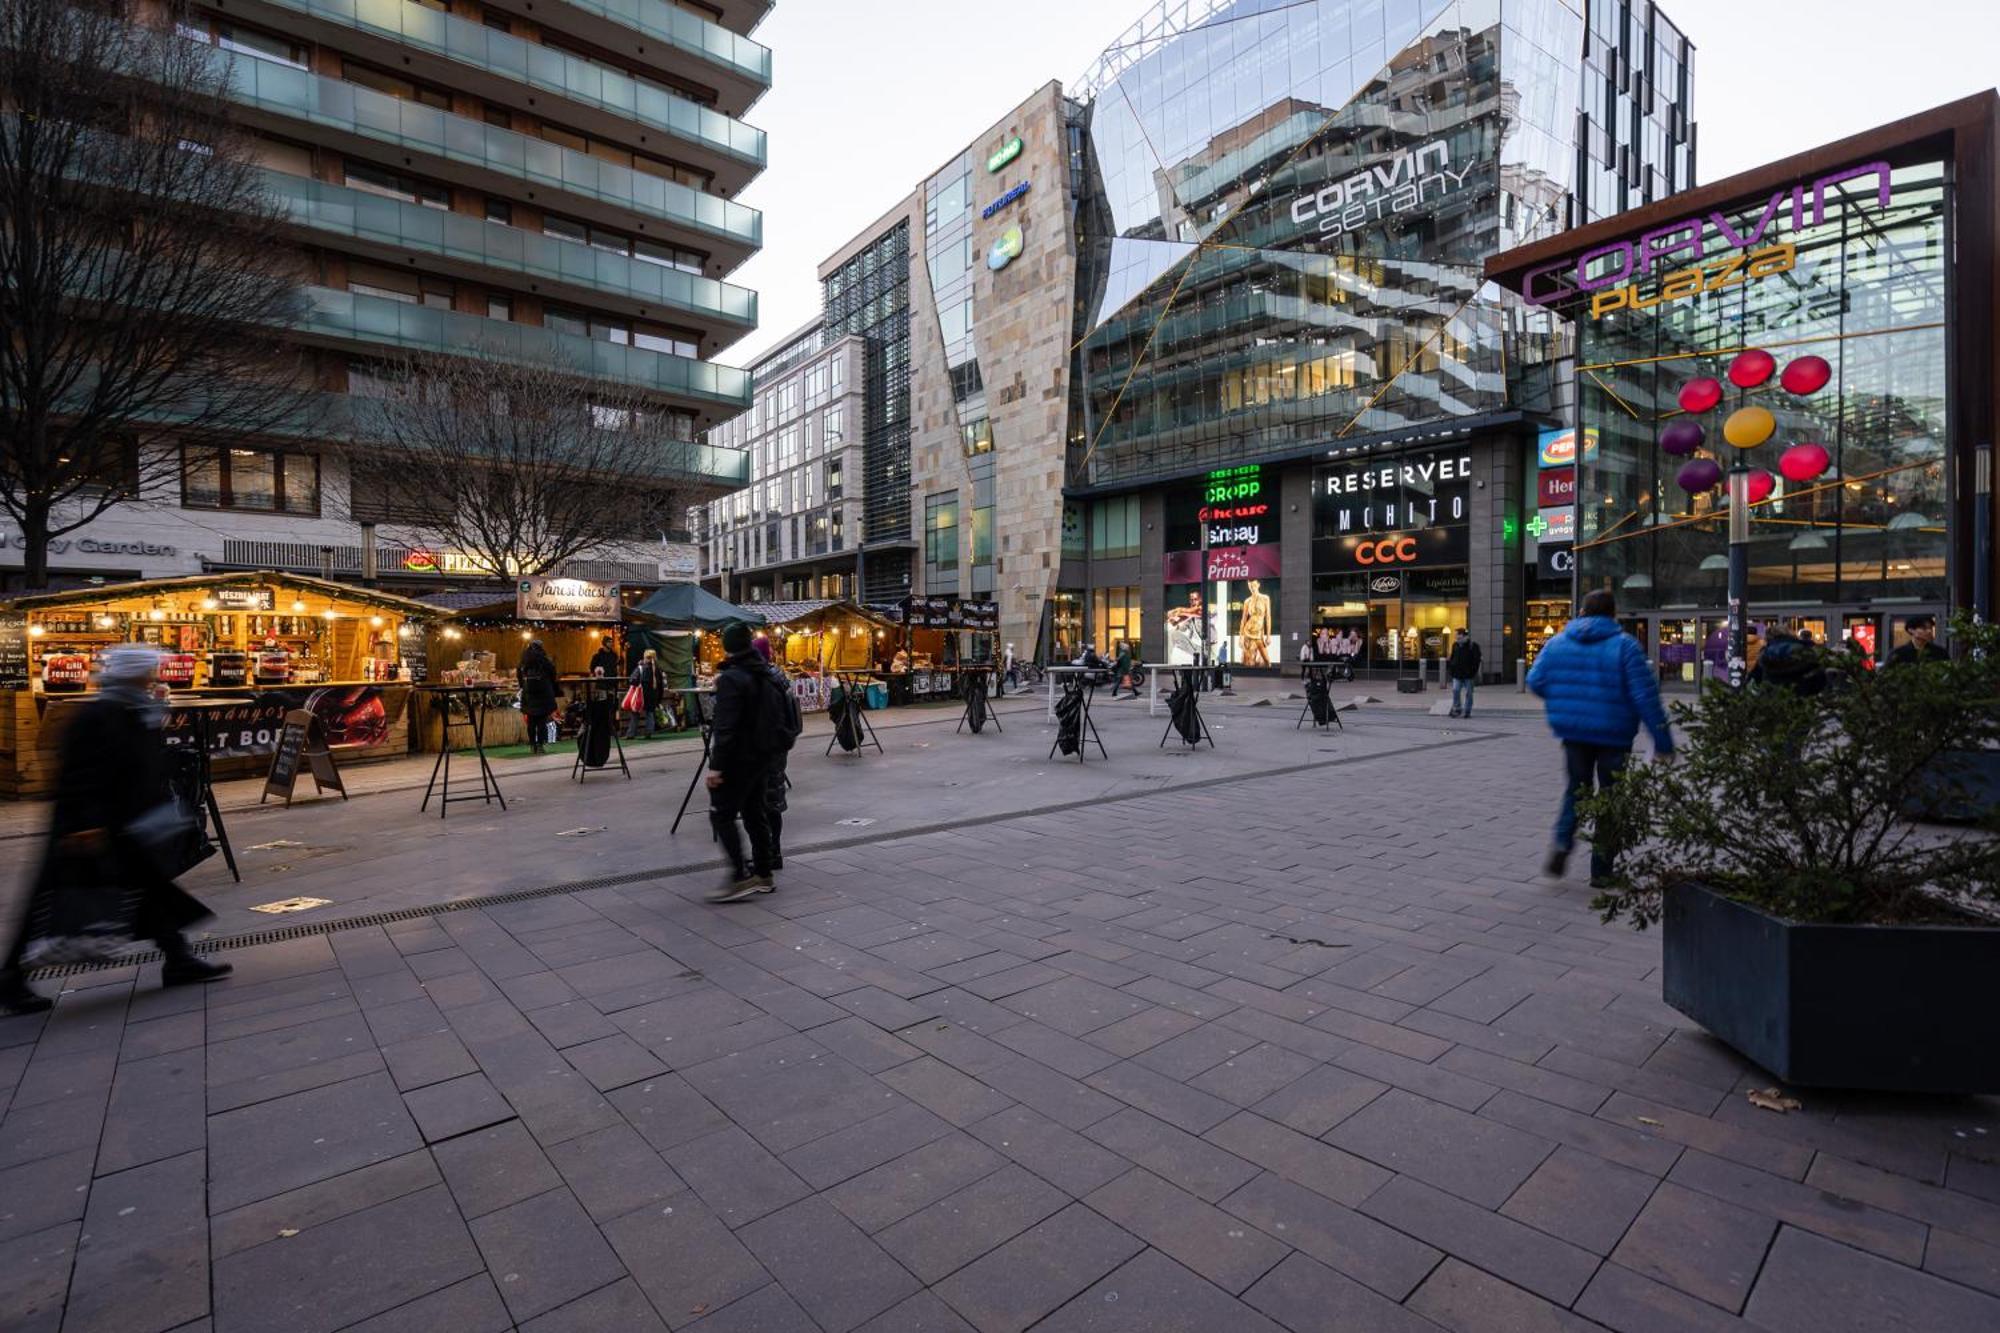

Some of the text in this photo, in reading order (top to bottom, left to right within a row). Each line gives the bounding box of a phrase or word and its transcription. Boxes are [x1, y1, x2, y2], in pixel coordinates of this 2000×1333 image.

[1291, 139, 1449, 224] CORVIN
[1522, 161, 1892, 306] CORVIN
[1551, 438, 1594, 454] PEPO
[1327, 457, 1471, 495] RESERVED
[1206, 481, 1260, 502] CROPP
[1549, 479, 1574, 495] Her
[1214, 505, 1268, 519] house
[1339, 496, 1462, 531] MOHITO
[1210, 525, 1259, 545] sinsay
[11, 536, 71, 555] Cy
[76, 537, 177, 557] Garden
[1355, 537, 1418, 565] CCC
